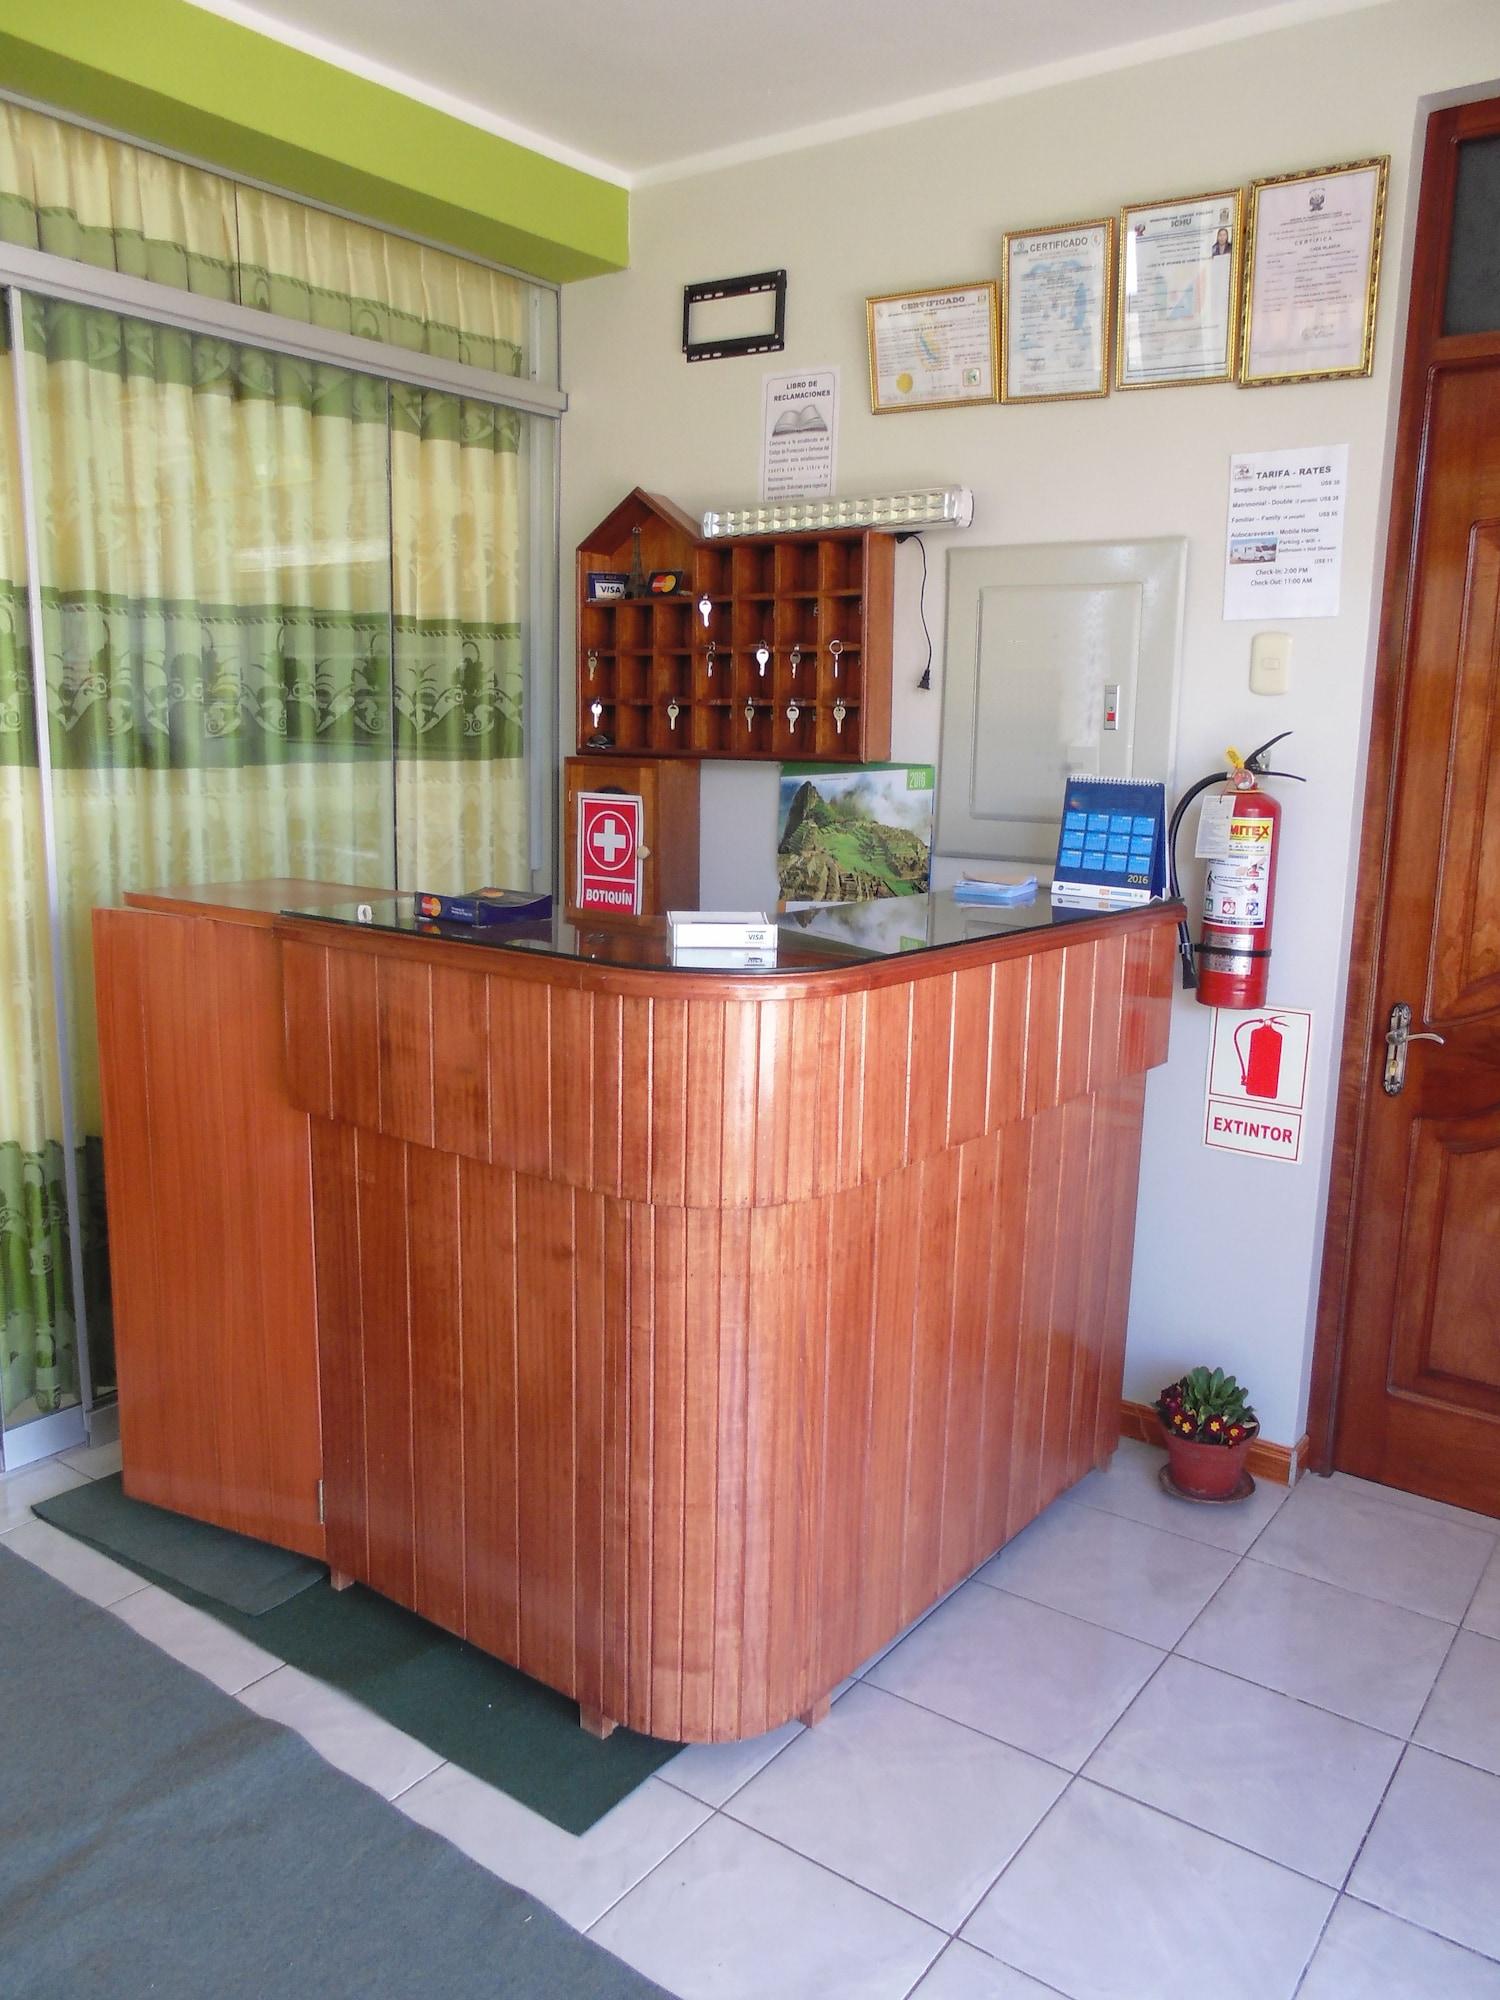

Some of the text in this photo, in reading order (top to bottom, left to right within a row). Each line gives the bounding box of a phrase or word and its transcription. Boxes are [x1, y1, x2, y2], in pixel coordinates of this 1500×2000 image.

[1029, 236, 1088, 252] CERTIFICADO
[901, 295, 965, 310] CERTIFICADO
[786, 380, 818, 390] LIBRO DE
[774, 390, 831, 402] RECLAMACIONES
[1256, 469, 1290, 479] TARIFA
[1299, 466, 1332, 476] RATES
[1128, 874, 1148, 884] 2016
[586, 888, 632, 906] BOTIQUÍN
[1213, 1116, 1293, 1144] EXTINTOR
